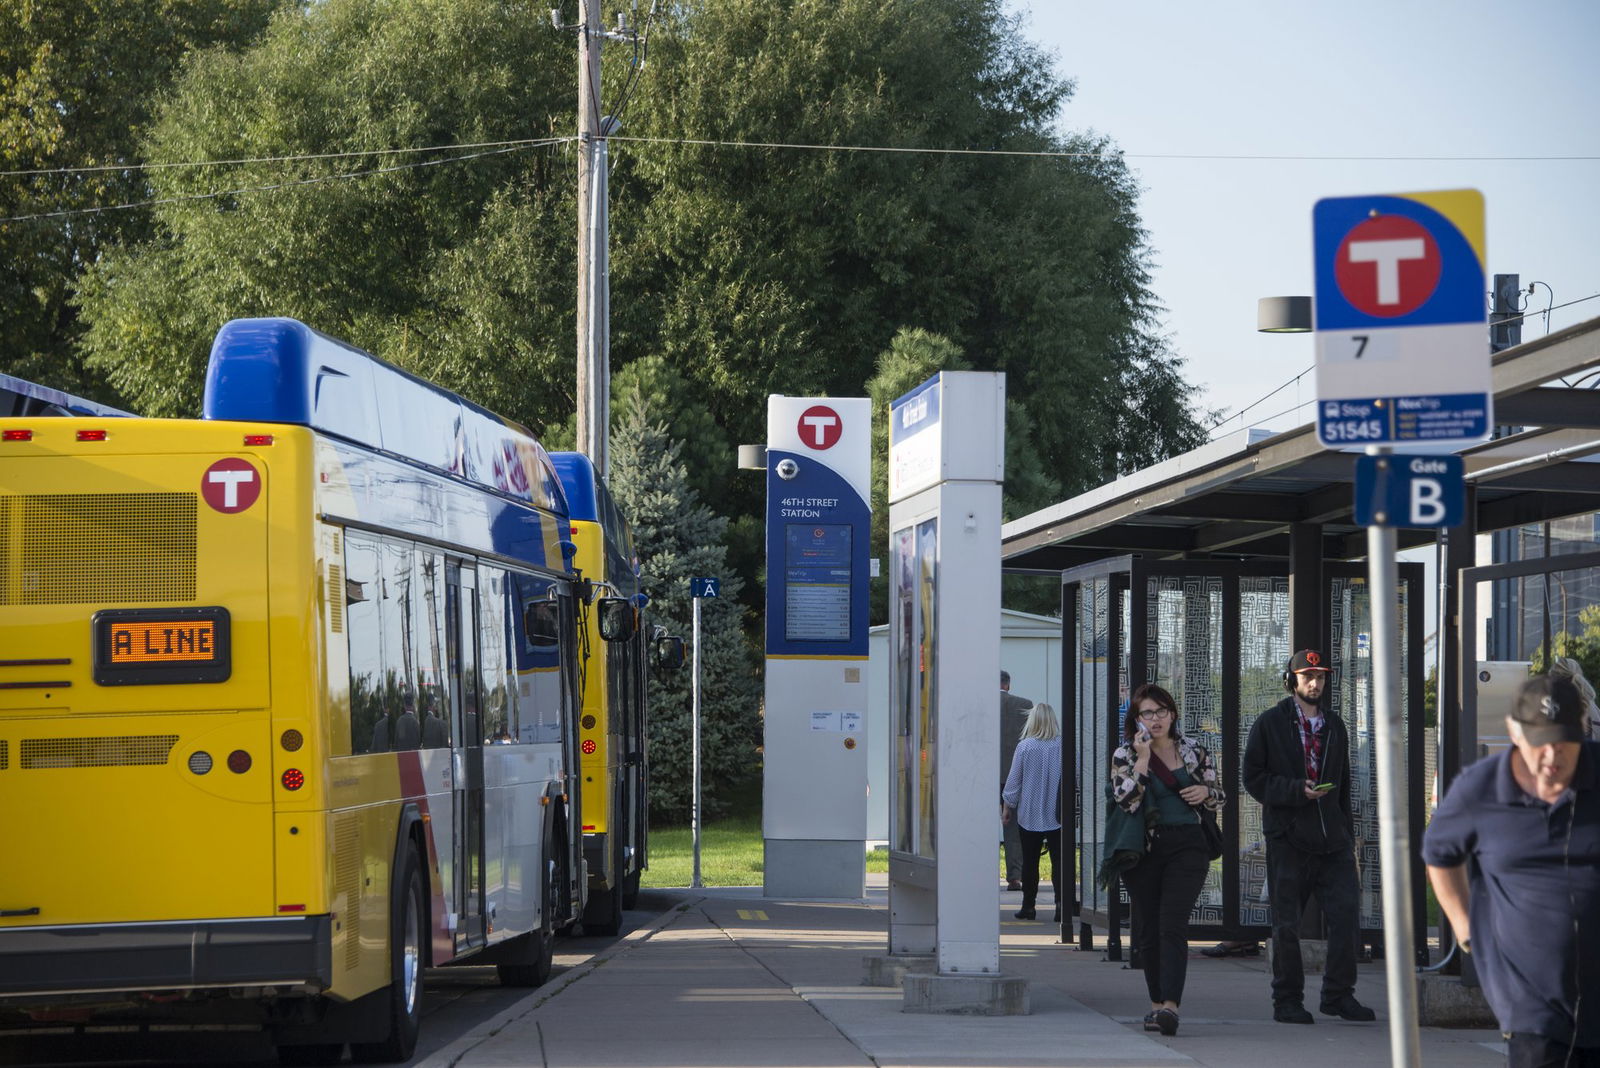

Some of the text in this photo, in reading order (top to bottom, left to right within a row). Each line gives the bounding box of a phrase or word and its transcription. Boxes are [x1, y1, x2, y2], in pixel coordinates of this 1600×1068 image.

[1348, 237, 1426, 306] T
[1351, 335, 1369, 359] 7
[1341, 402, 1371, 418] Stop
[803, 416, 836, 445] T
[1325, 420, 1382, 441] 51545
[1410, 458, 1448, 474] Gate
[208, 469, 254, 508] T
[781, 498, 838, 507] 46TH STREET
[1409, 477, 1446, 525] B
[781, 508, 820, 518] STATION
[704, 584, 716, 597] A
[115, 628, 211, 655] A LINE
